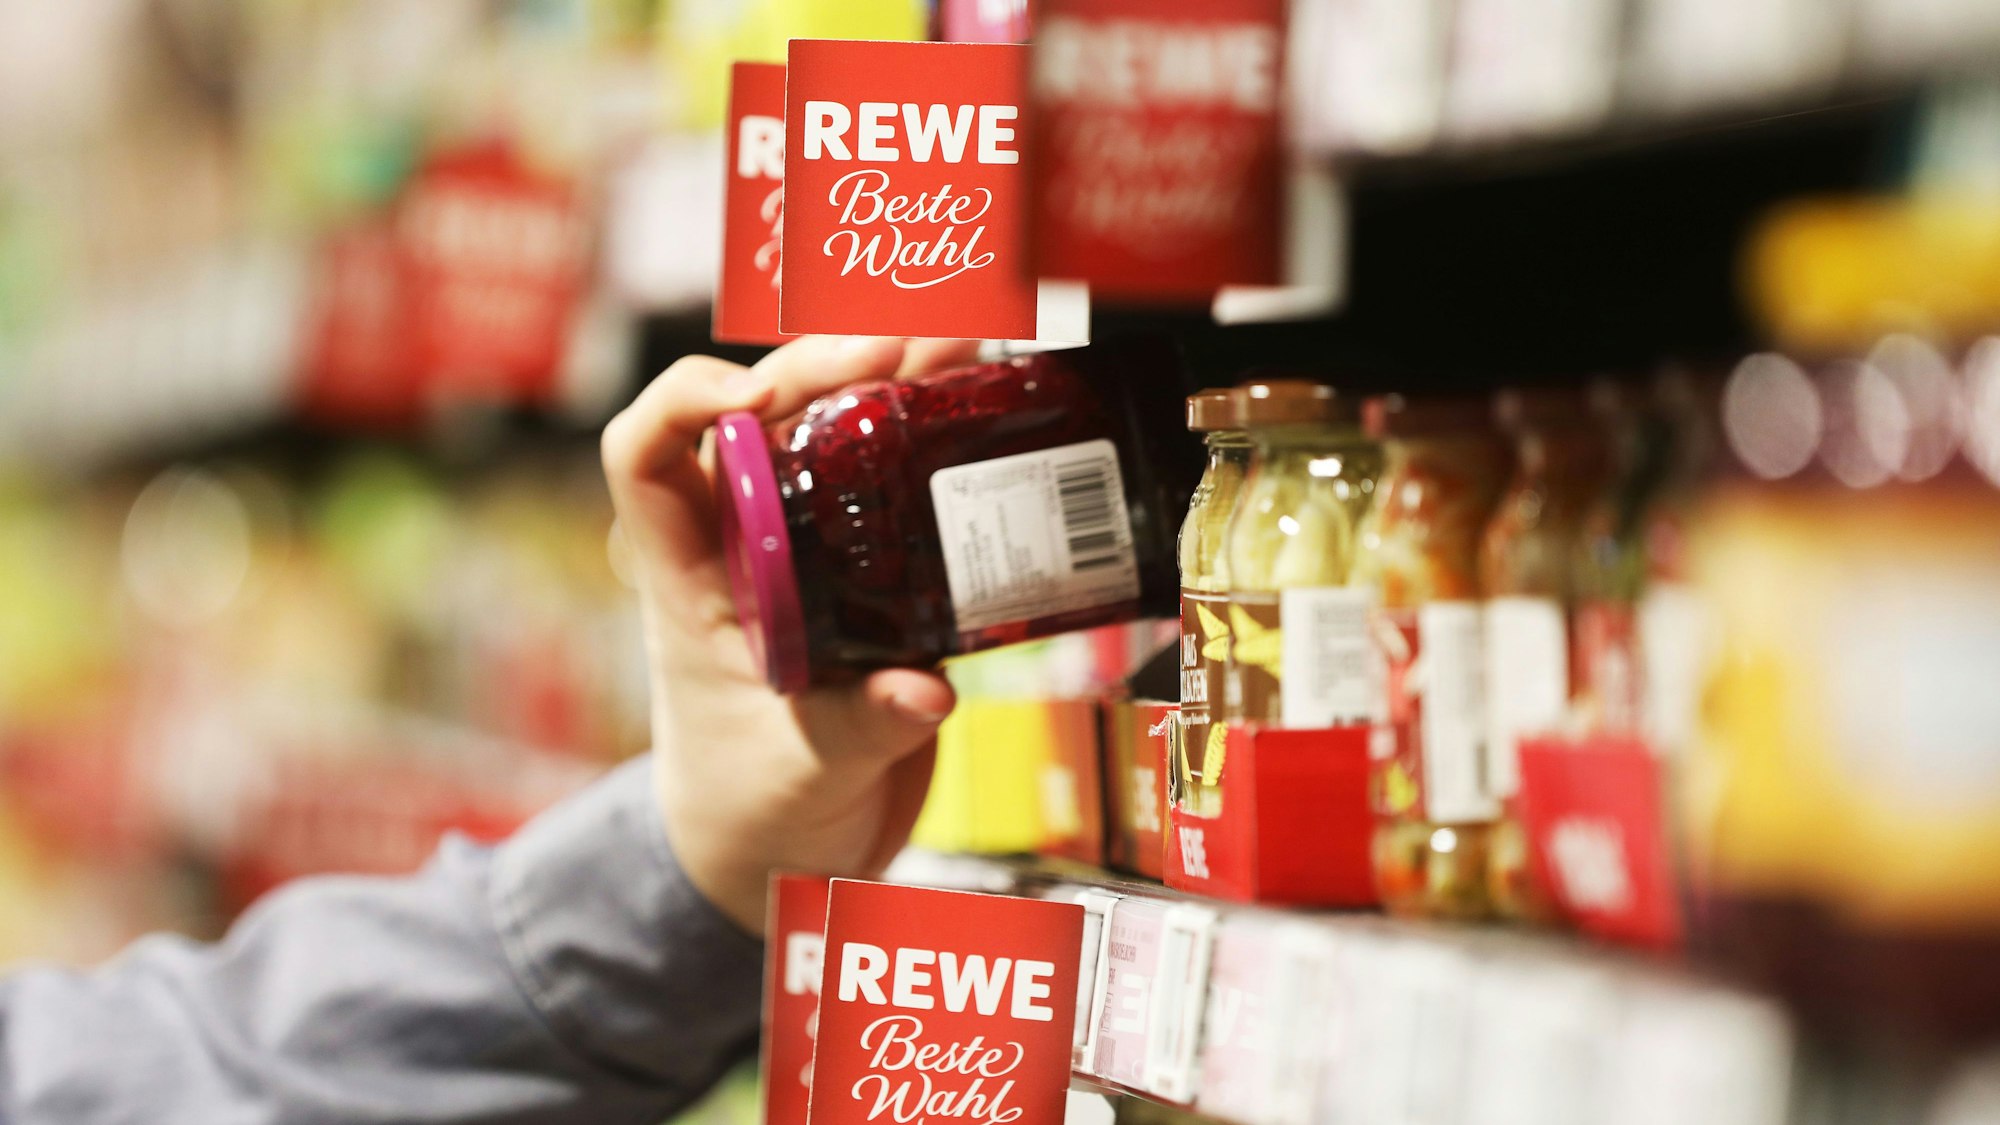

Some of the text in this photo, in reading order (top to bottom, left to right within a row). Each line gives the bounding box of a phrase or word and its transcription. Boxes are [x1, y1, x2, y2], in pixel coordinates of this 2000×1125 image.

[803, 100, 1019, 165] REWE
[828, 169, 993, 225] Beste
[822, 225, 995, 290] Wahl
[838, 942, 1055, 1022] REWE
[860, 1014, 1025, 1078] Beste
[851, 1072, 1024, 1125] Wahl
